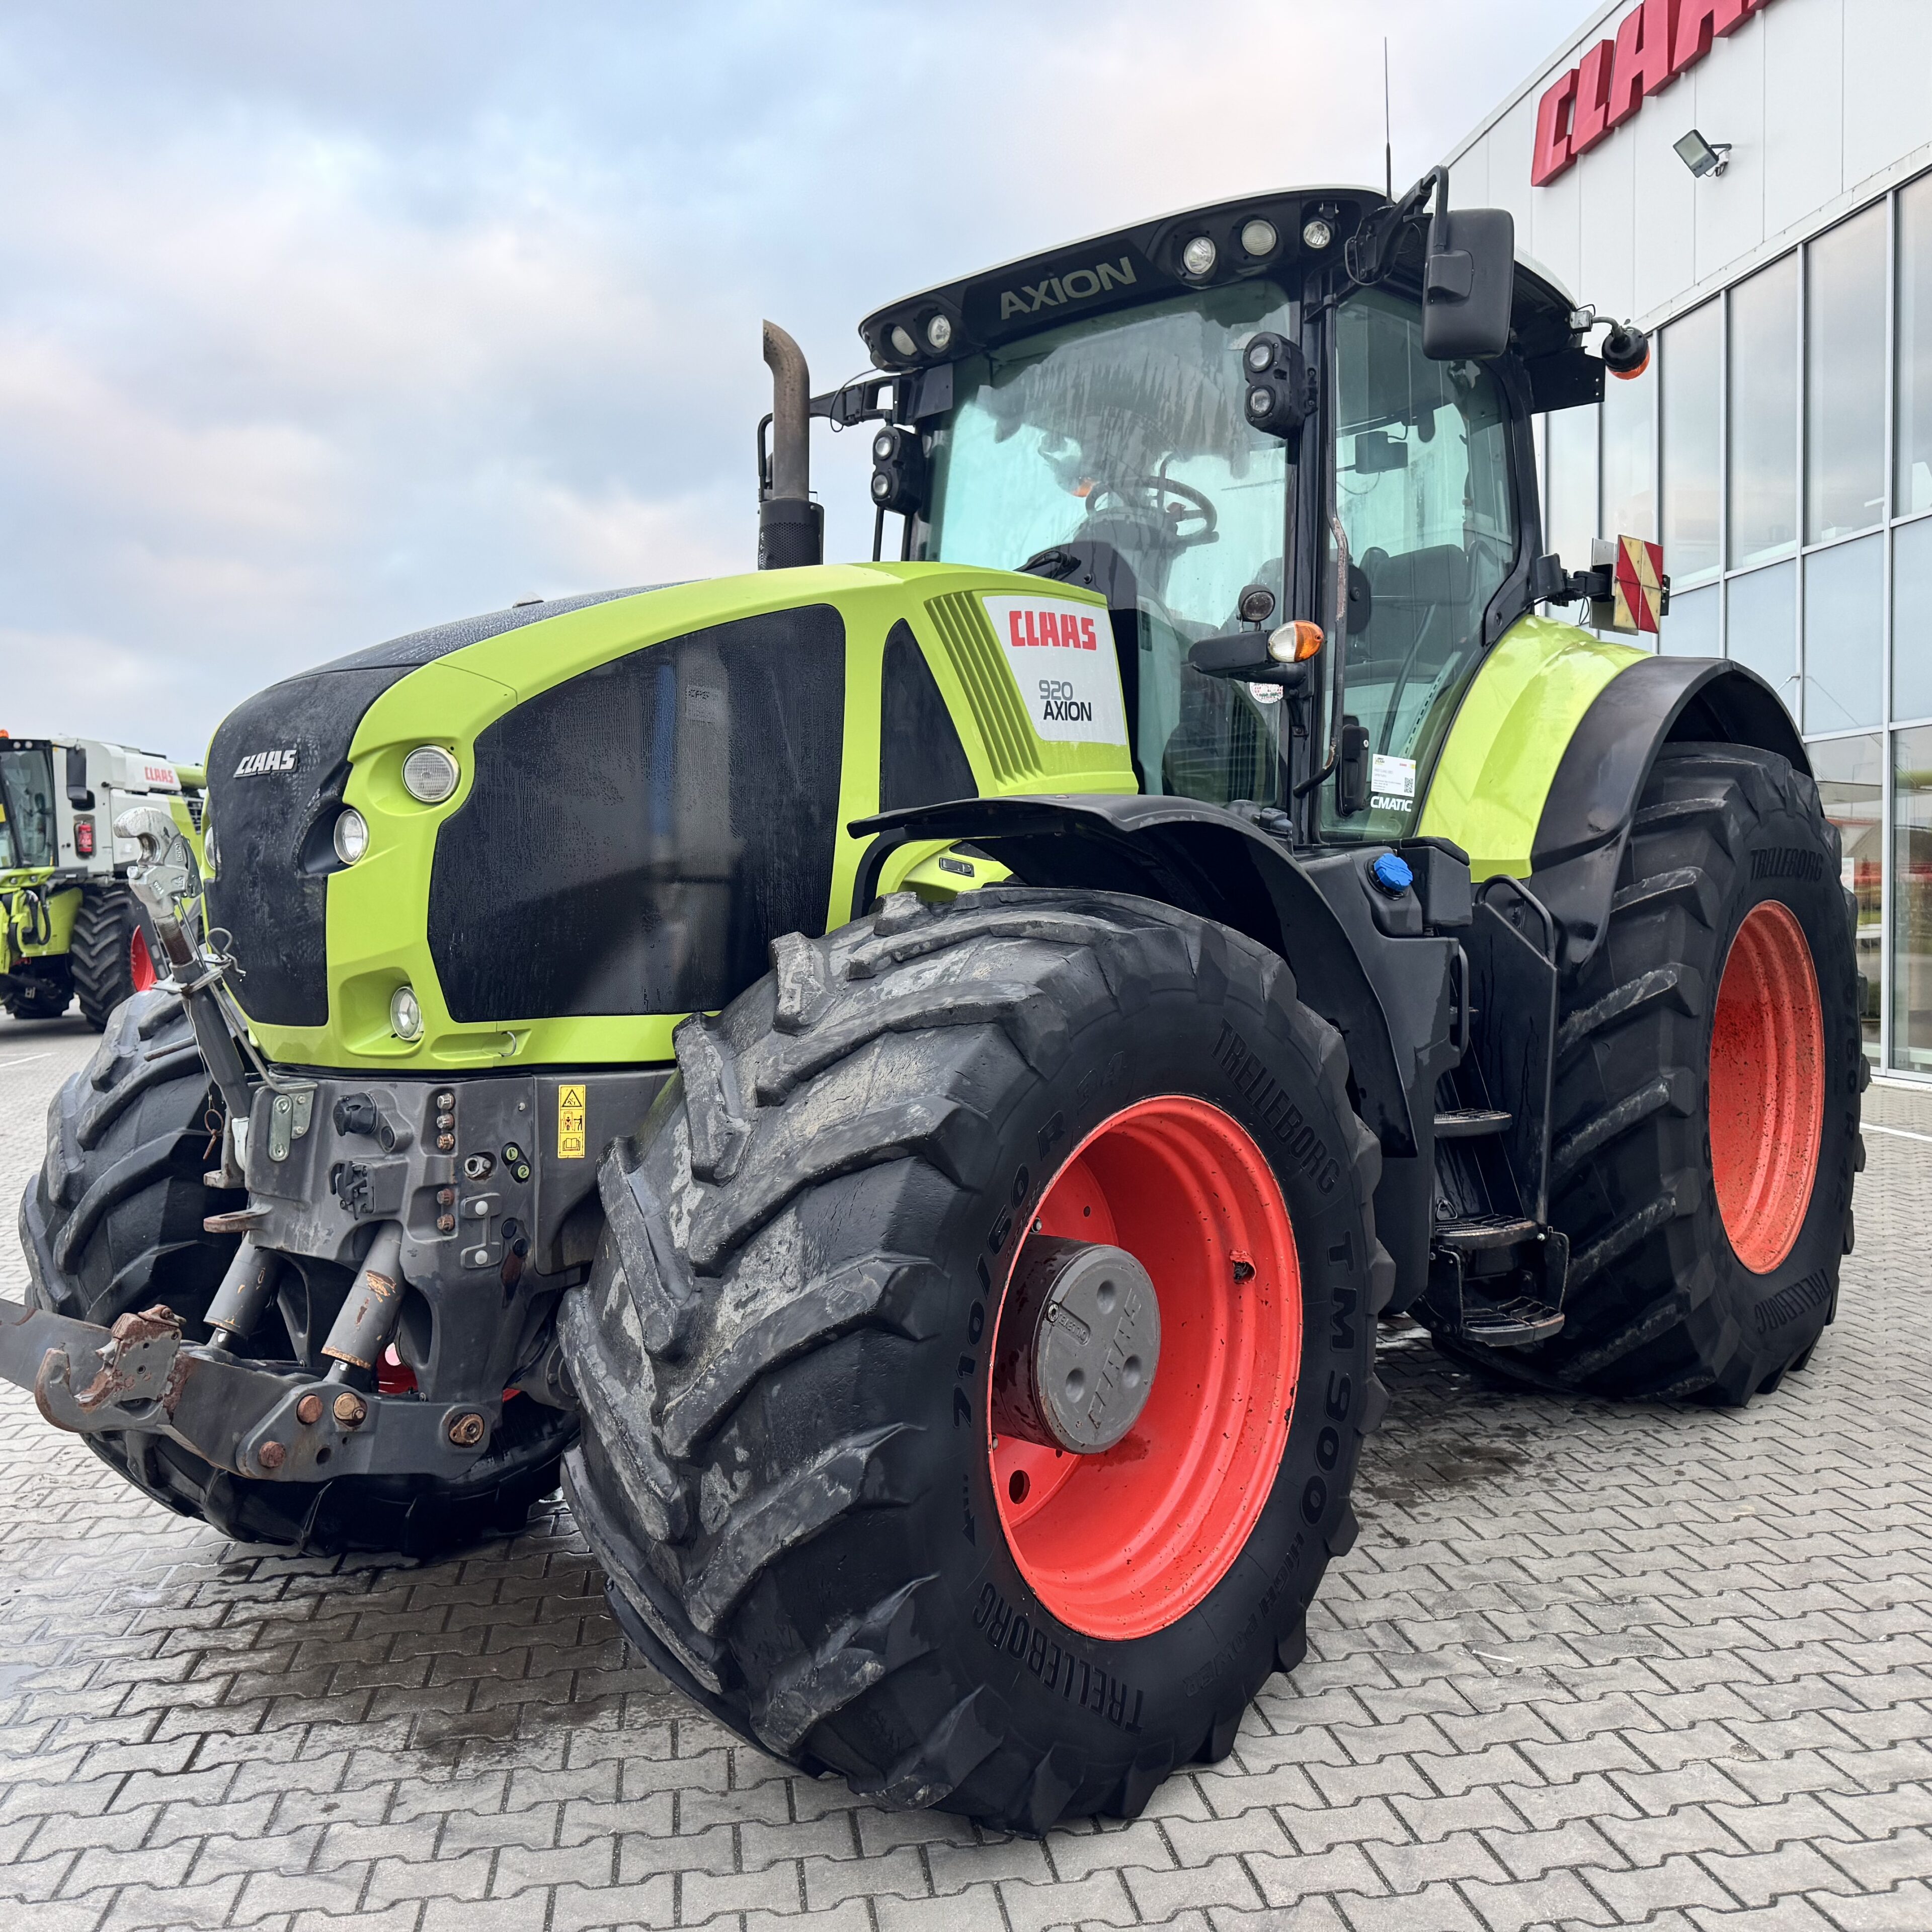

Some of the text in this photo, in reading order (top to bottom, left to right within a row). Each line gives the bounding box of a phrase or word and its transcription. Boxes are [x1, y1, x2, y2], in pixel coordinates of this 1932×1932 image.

[1531, 0, 1772, 187] CLAA
[1001, 257, 1137, 320] AXION
[1009, 611, 1096, 651] CLAAS
[1039, 680, 1073, 700] 920
[1043, 700, 1092, 721] AXION
[144, 766, 174, 783] CLAAS
[234, 749, 298, 778] CLAAS
[1370, 796, 1413, 812] CMATIC
[1750, 847, 1824, 883] TRELLEBORG
[1211, 1016, 1340, 1195] TRELLEBORG
[1301, 1371, 1352, 1528] 900
[1259, 1531, 1306, 1618] HIGH
[972, 1582, 1144, 1735] TRELLEBORG
